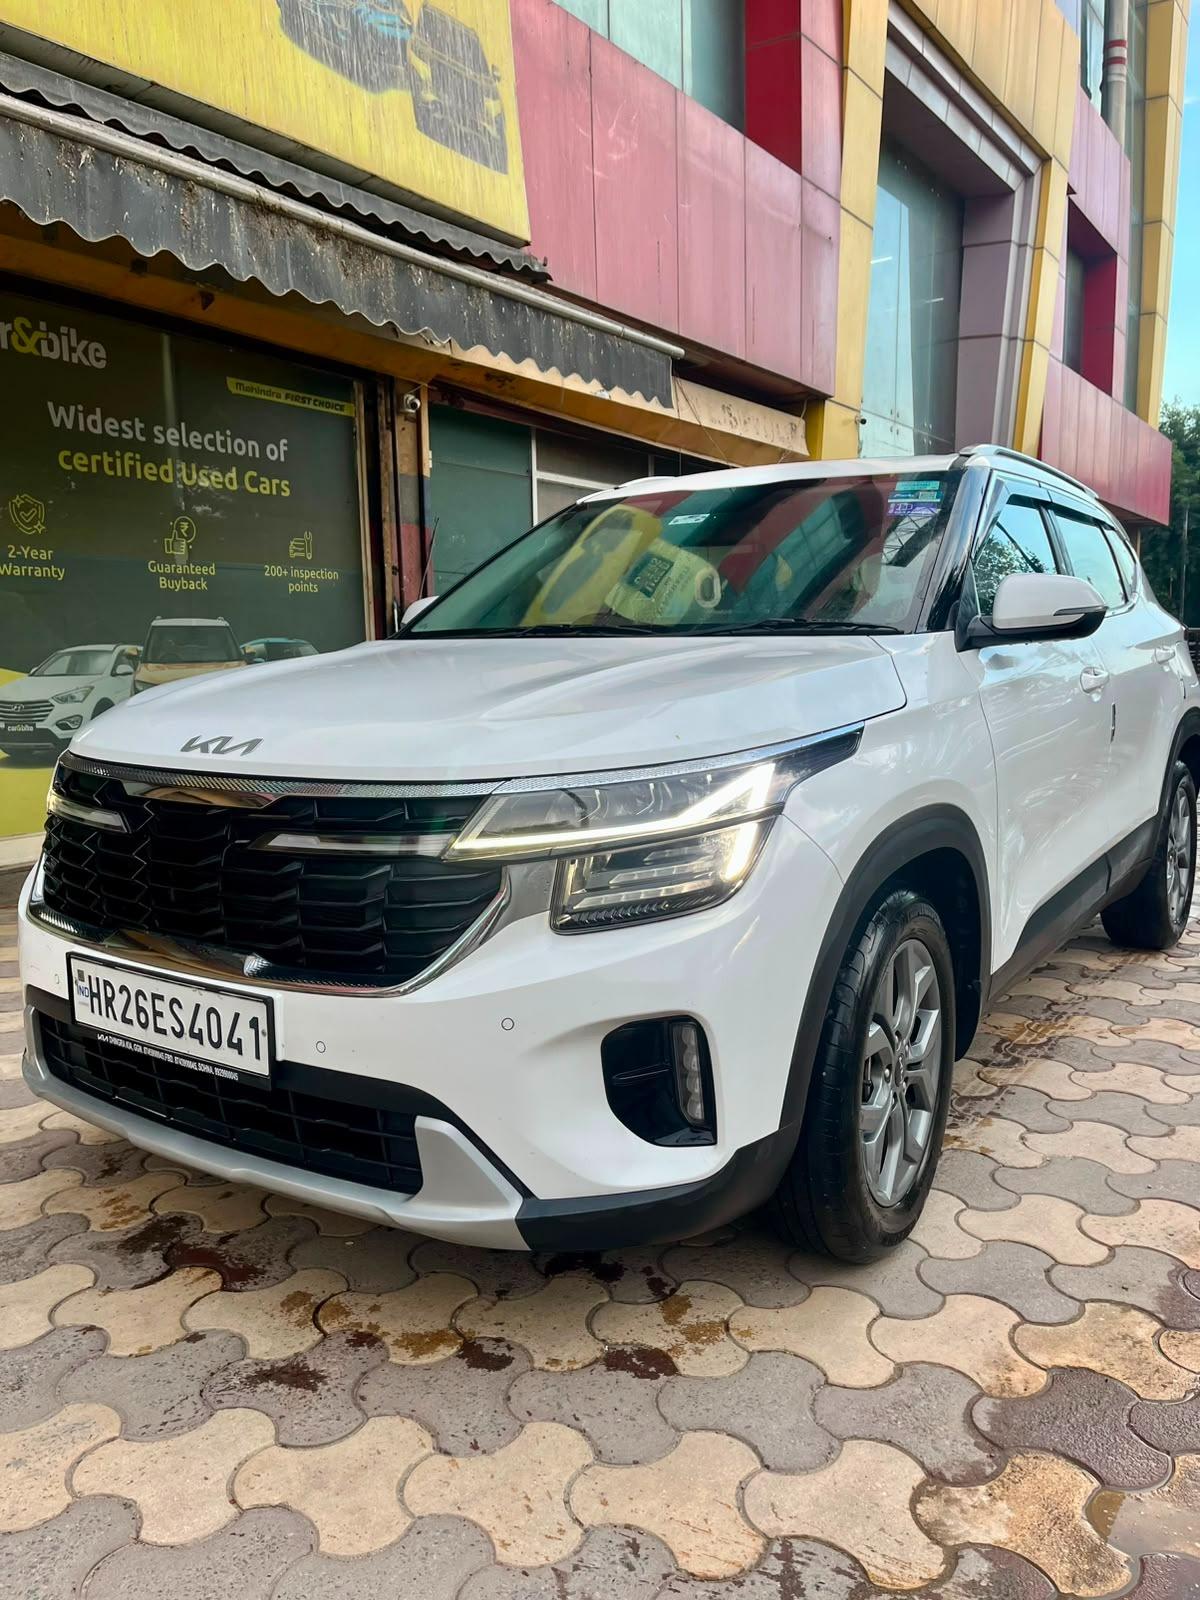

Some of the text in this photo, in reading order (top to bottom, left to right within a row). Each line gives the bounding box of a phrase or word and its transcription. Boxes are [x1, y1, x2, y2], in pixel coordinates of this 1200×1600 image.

[47, 401, 288, 462] Widest selection of
[58, 450, 291, 497] certified Used Cars
[7, 544, 54, 560] 2-Year
[0, 562, 65, 581] Warranty
[147, 560, 216, 576] Guaranteed
[264, 564, 339, 581] 200+ inspection
[159, 576, 208, 592] Buyback
[288, 581, 319, 593] points
[180, 735, 264, 757] KIA
[88, 975, 261, 1060] HR26ES4041
